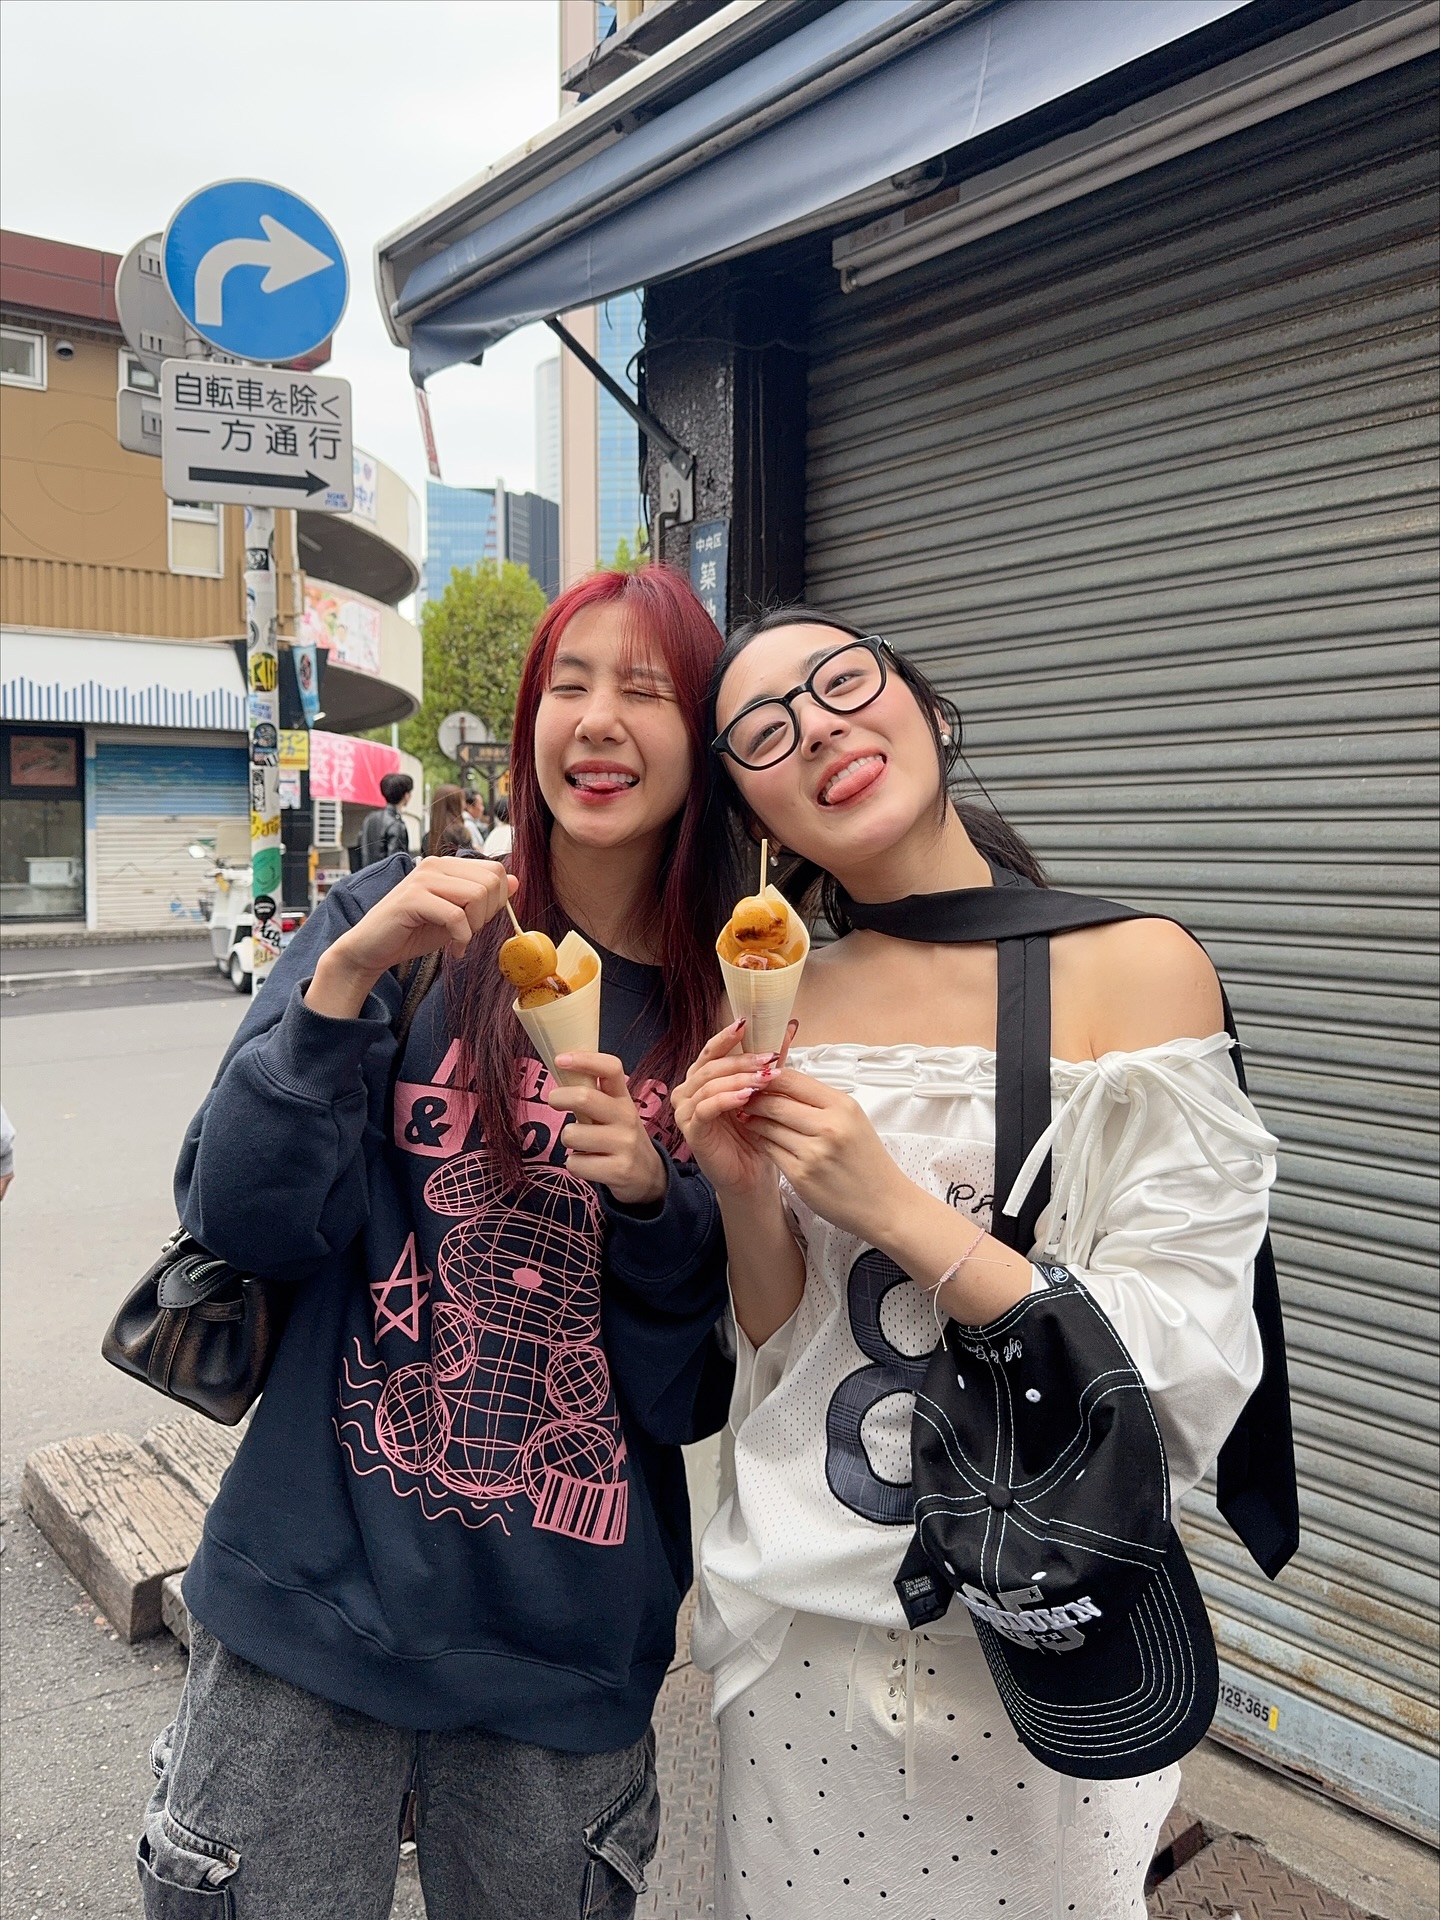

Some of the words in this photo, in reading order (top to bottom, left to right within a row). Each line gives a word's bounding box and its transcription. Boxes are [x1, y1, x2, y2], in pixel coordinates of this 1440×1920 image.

[175, 372, 340, 419] 自転車を除く
[176, 419, 342, 461] 一方通行
[695, 532, 722, 553] 中央区
[403, 1095, 453, 1147] &
[990, 1349, 999, 1364] &
[1003, 1337, 1023, 1363] Soft
